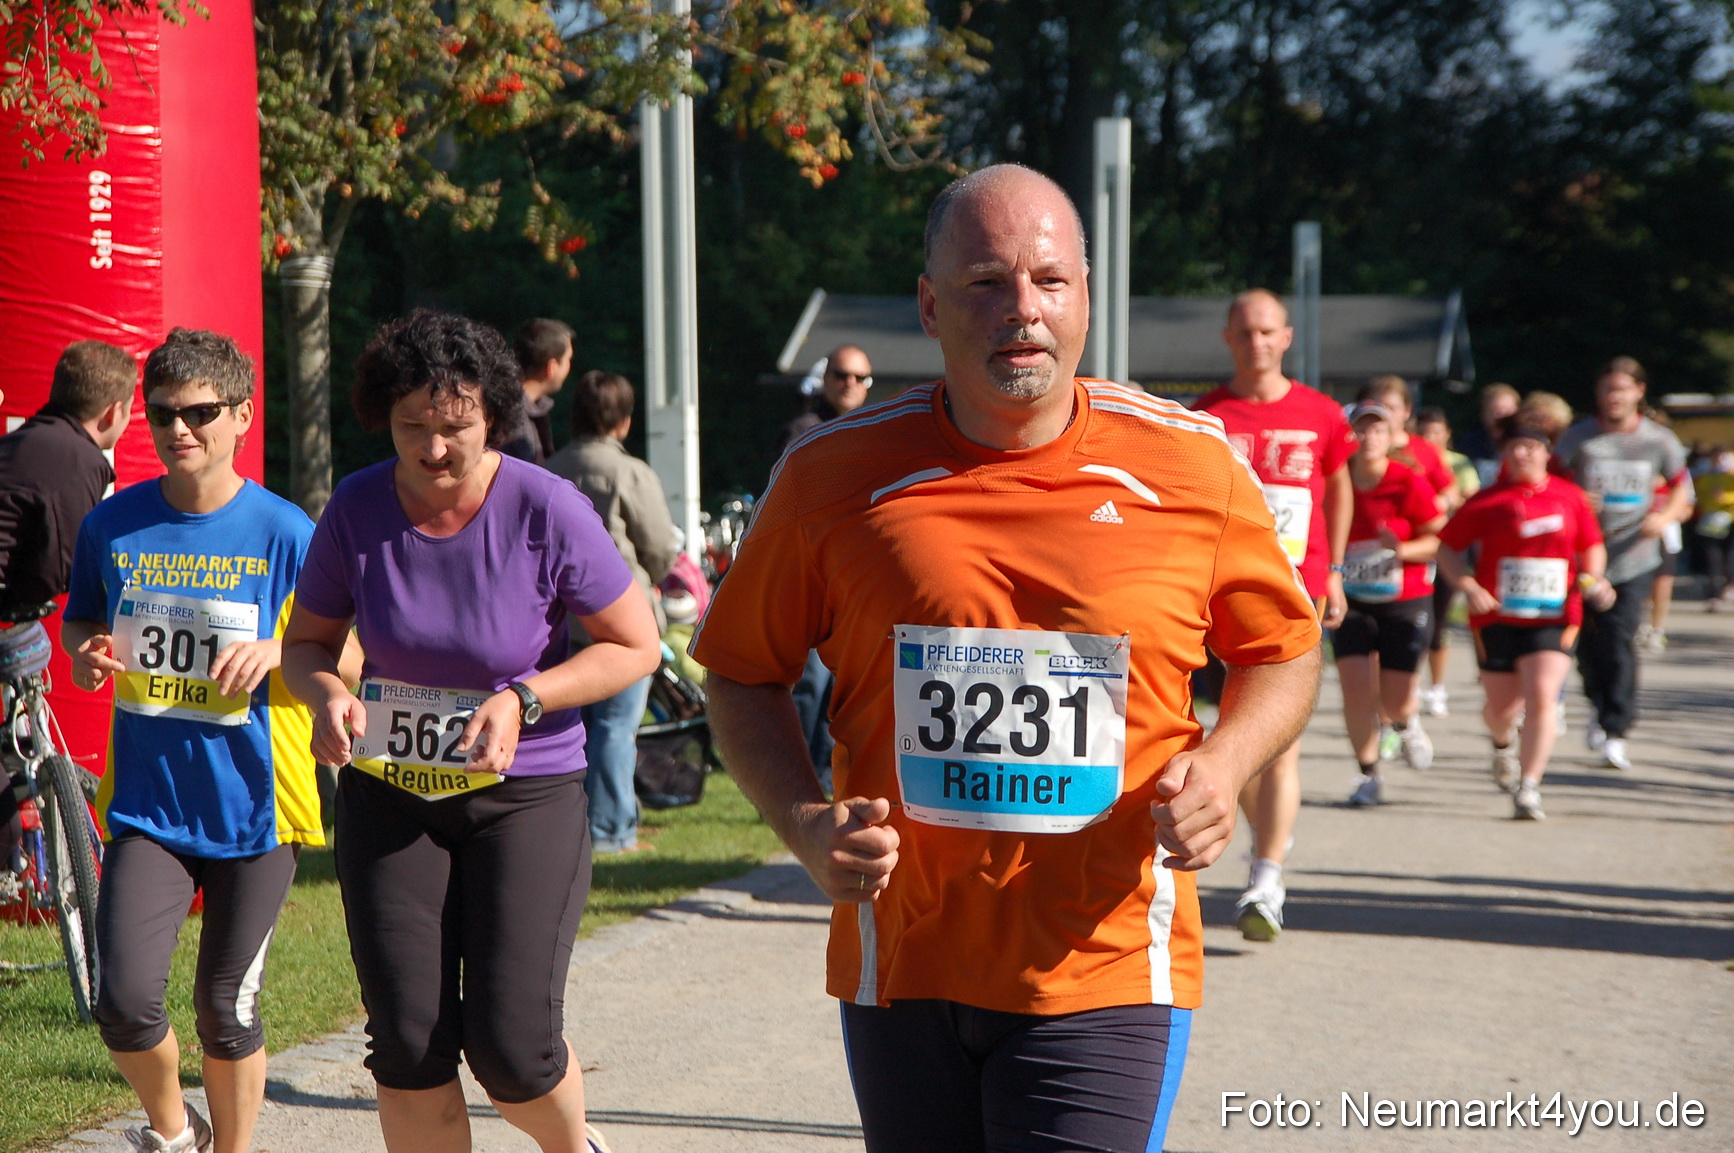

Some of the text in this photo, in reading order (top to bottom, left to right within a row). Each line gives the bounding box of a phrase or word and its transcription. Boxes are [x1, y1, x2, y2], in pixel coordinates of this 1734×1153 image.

[88, 170, 113, 269] Seit 1929
[1090, 513, 1124, 525] adidas
[112, 552, 269, 576] 10. NEUMARKTER
[132, 569, 241, 590] STADTLAUF
[136, 601, 195, 619] PFLEIDERER
[139, 625, 219, 681] 301
[927, 644, 1024, 665] PFLEIDERER
[1049, 655, 1108, 670] BOCK
[926, 663, 1024, 676] AKTIENGESELLSCHAFT
[148, 675, 208, 704] Erika
[384, 684, 442, 701] PFLEIDERER
[918, 680, 1089, 758] 3231
[387, 710, 471, 763] 562
[384, 762, 471, 794] Regina
[943, 761, 1072, 805] Rainer
